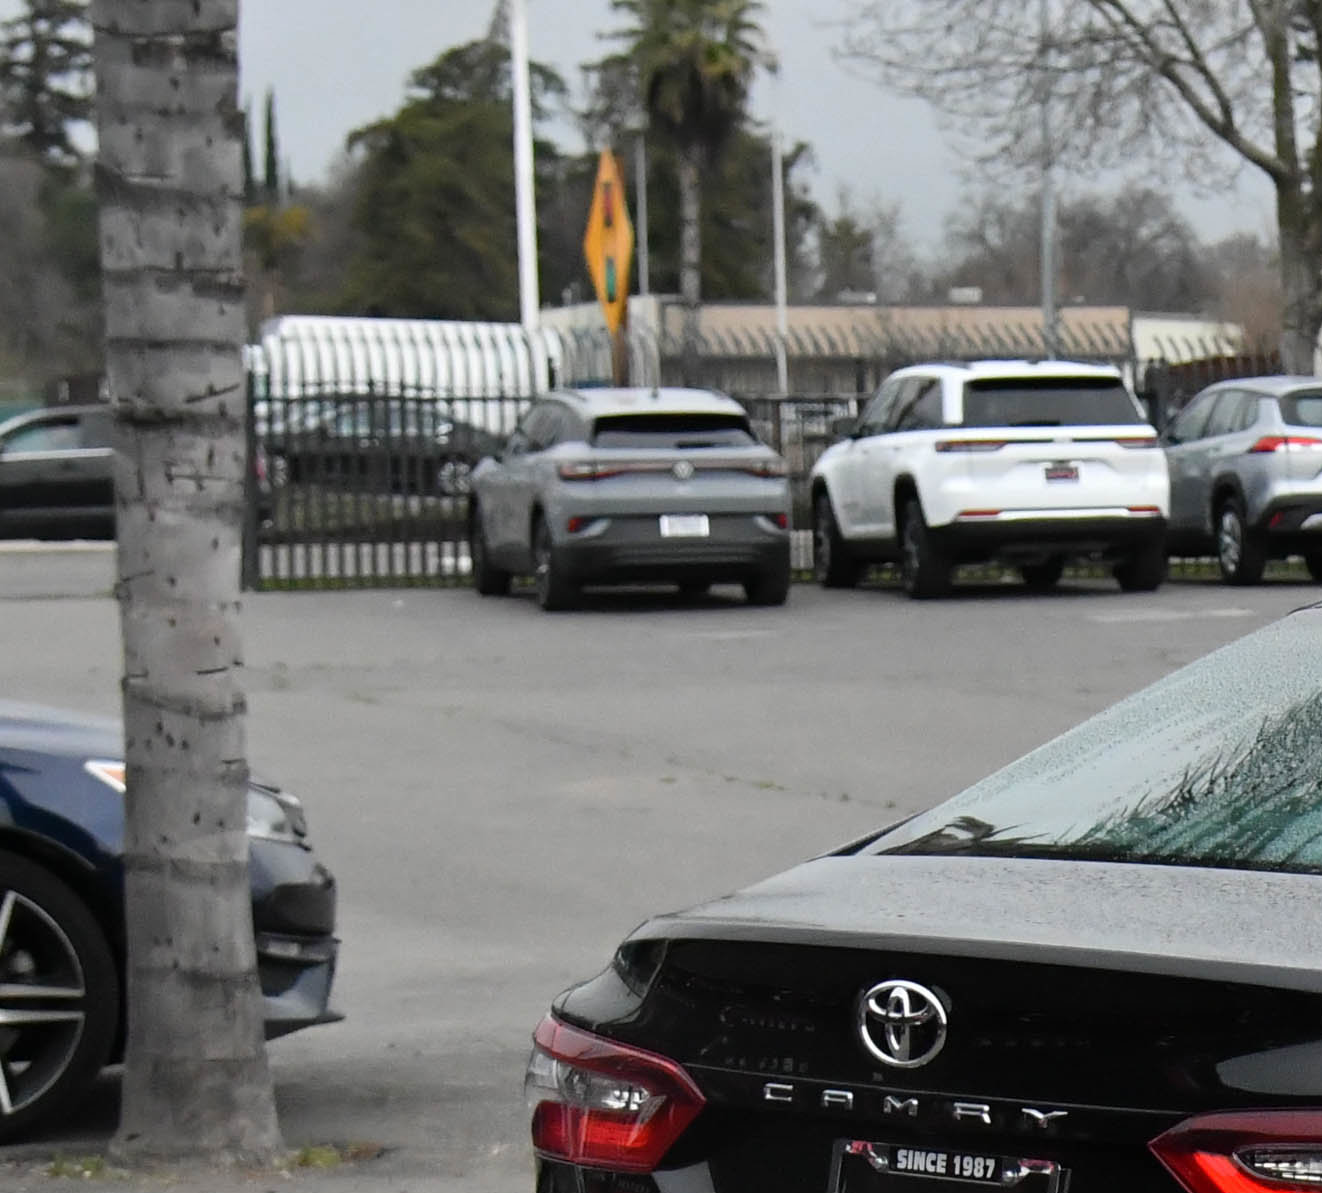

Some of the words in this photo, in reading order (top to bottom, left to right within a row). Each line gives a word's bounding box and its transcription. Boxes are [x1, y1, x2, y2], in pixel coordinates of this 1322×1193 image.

[763, 1082, 1069, 1129] CAMRY
[896, 1149, 947, 1174] SINCE
[953, 1156, 996, 1179] 1987
